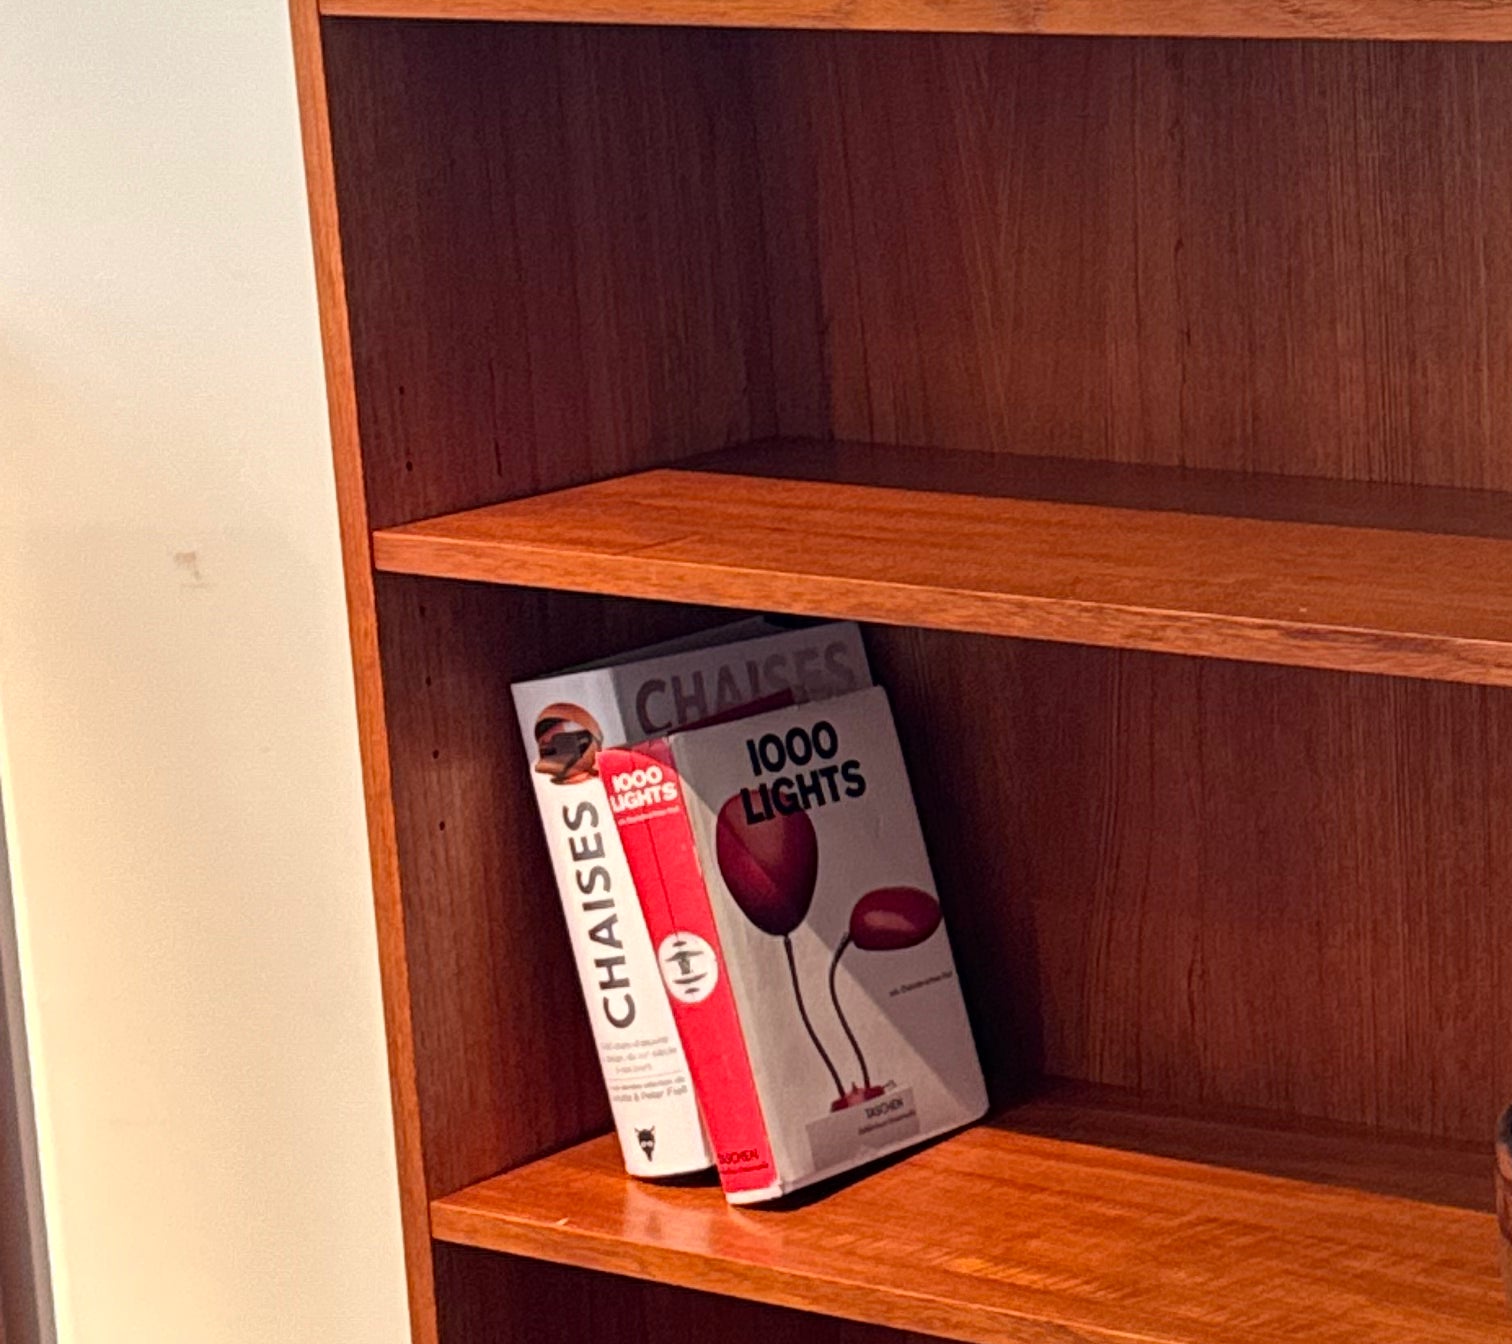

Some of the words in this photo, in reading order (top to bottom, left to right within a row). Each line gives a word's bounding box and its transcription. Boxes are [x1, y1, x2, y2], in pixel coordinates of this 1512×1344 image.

[636, 641, 856, 734] CHAISES
[746, 720, 838, 776] 1000
[609, 781, 677, 813] LIGHTS
[611, 765, 663, 793] 1000
[740, 759, 866, 825] LIGHTS
[562, 801, 636, 1029] CHAISES
